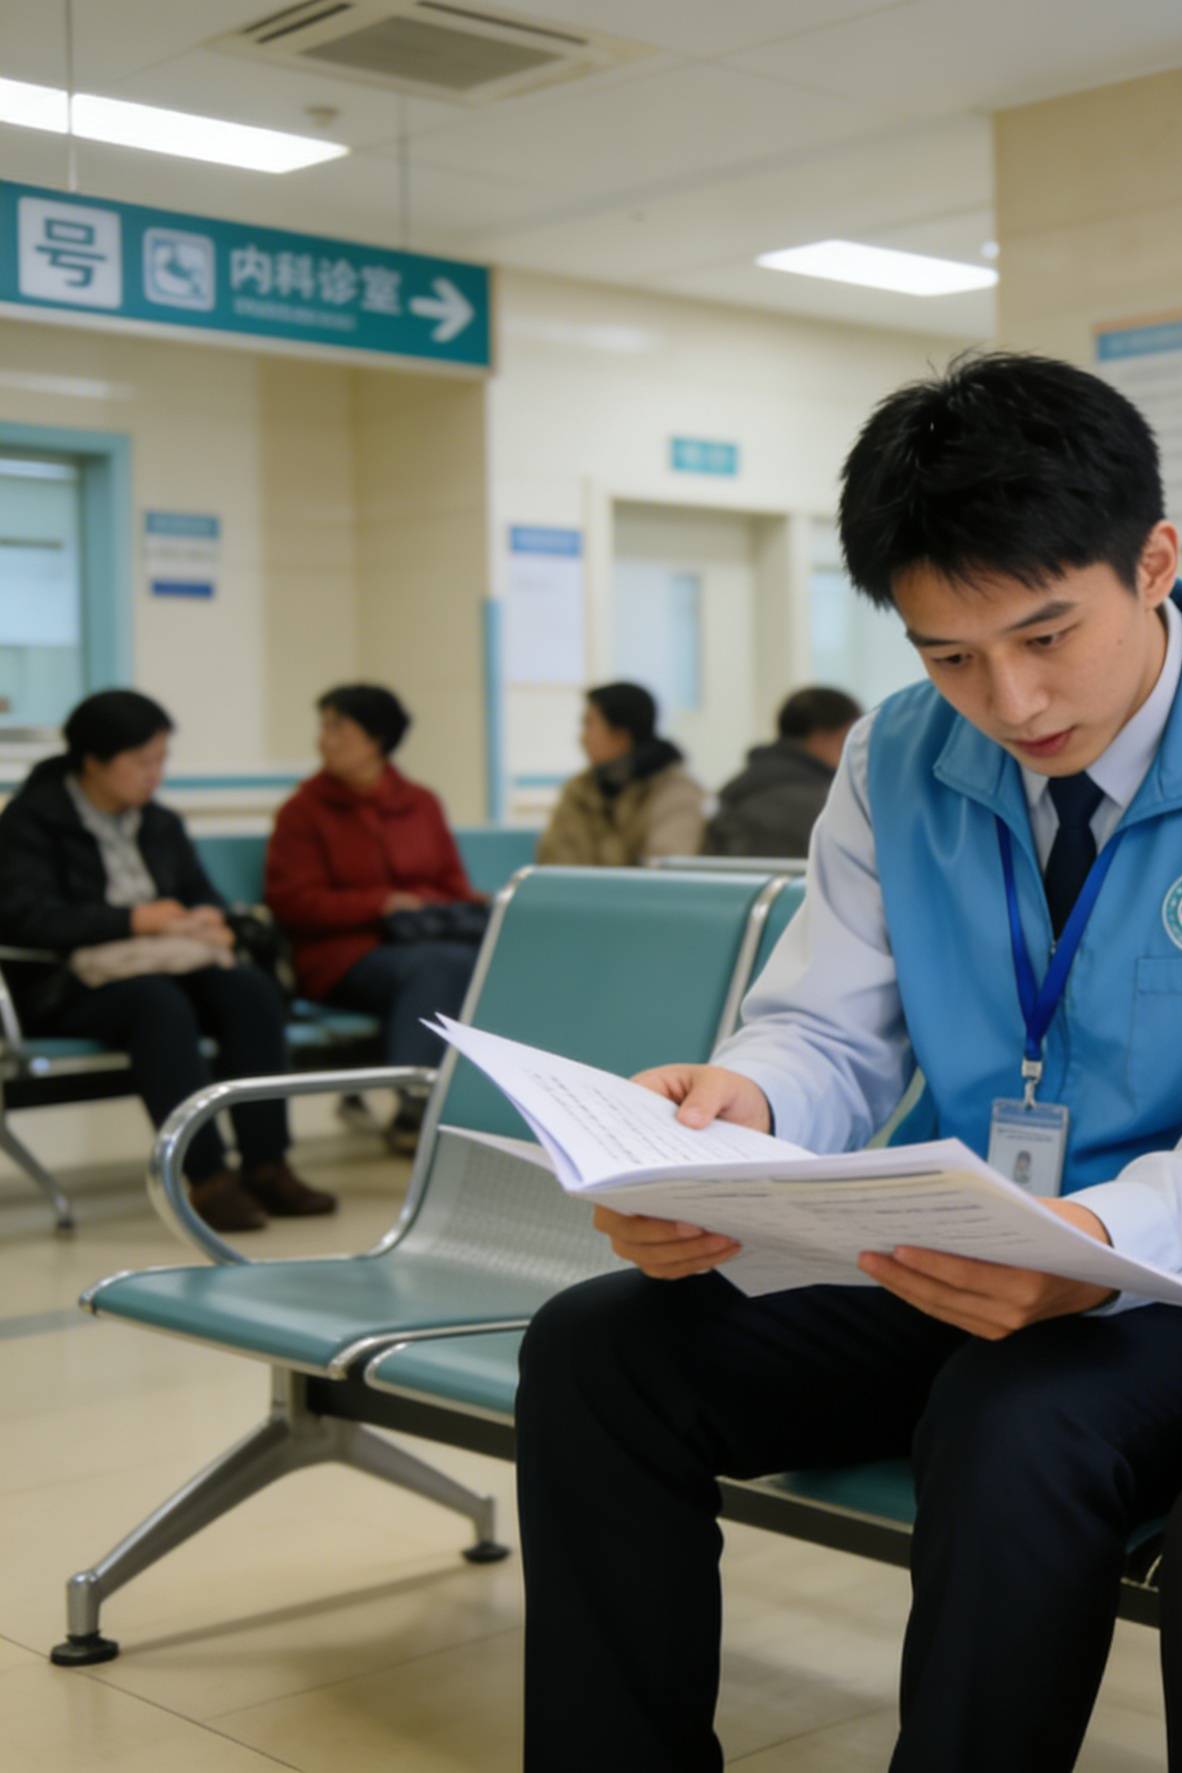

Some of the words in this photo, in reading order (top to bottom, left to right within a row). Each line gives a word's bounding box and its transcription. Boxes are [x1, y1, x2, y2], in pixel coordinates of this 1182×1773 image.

[35, 217, 107, 289] 号
[229, 242, 402, 316] 内科诊室
